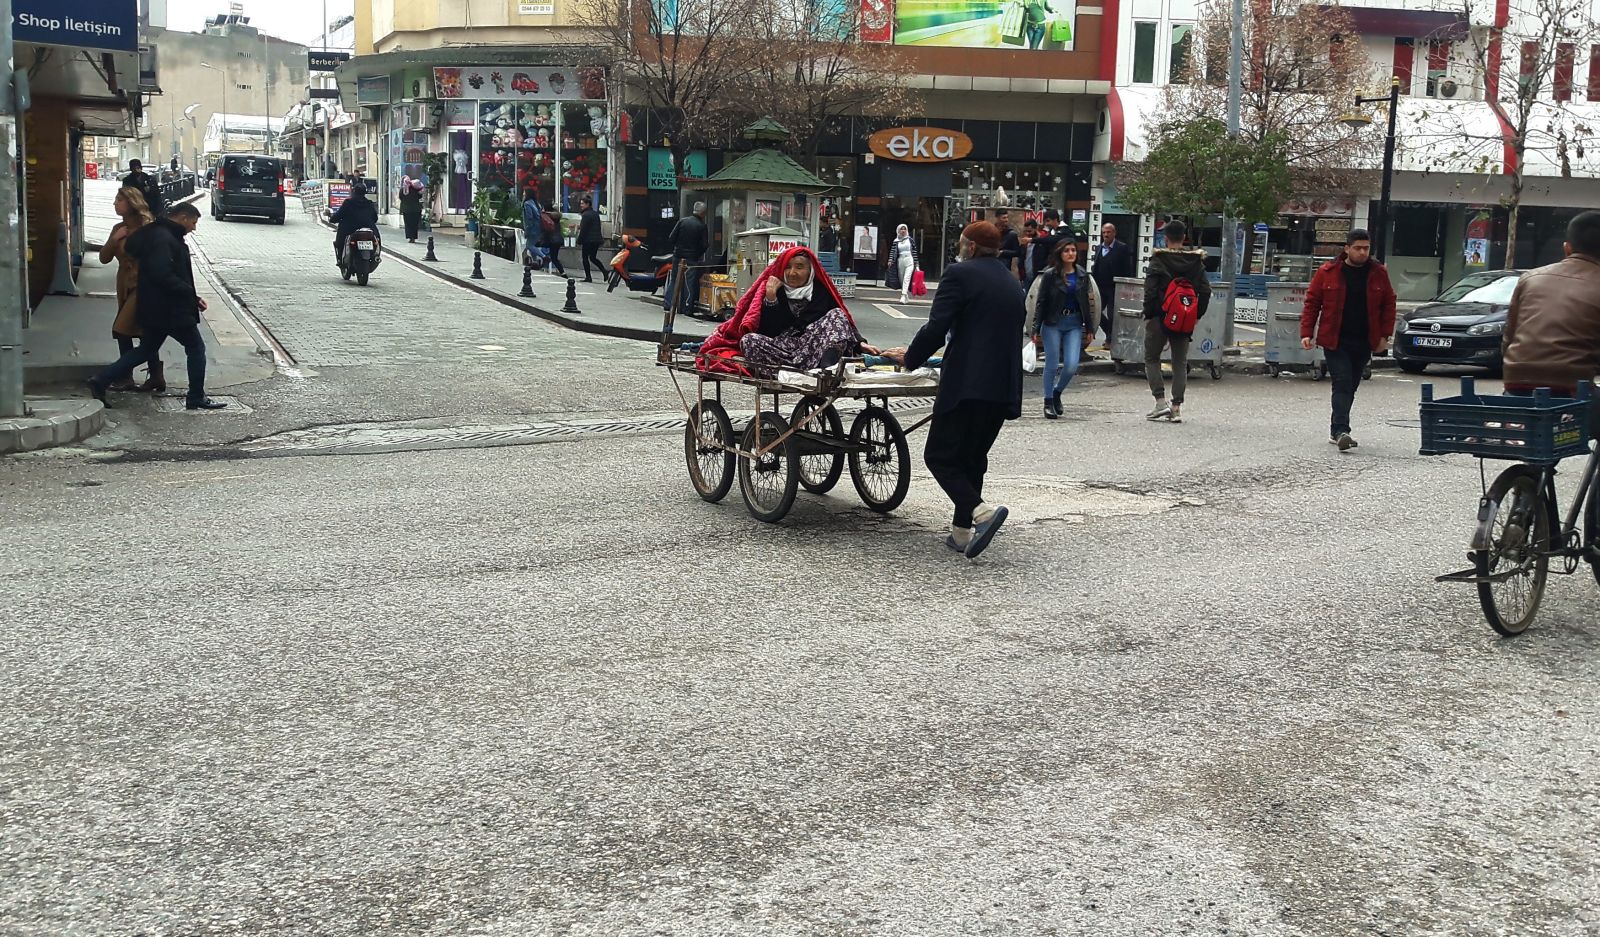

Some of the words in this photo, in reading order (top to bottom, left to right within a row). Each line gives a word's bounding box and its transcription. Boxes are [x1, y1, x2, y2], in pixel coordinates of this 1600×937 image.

[19, 13, 60, 31] Shop
[64, 16, 121, 36] İletişim
[886, 129, 954, 158] eka
[651, 179, 673, 187] KPSS
